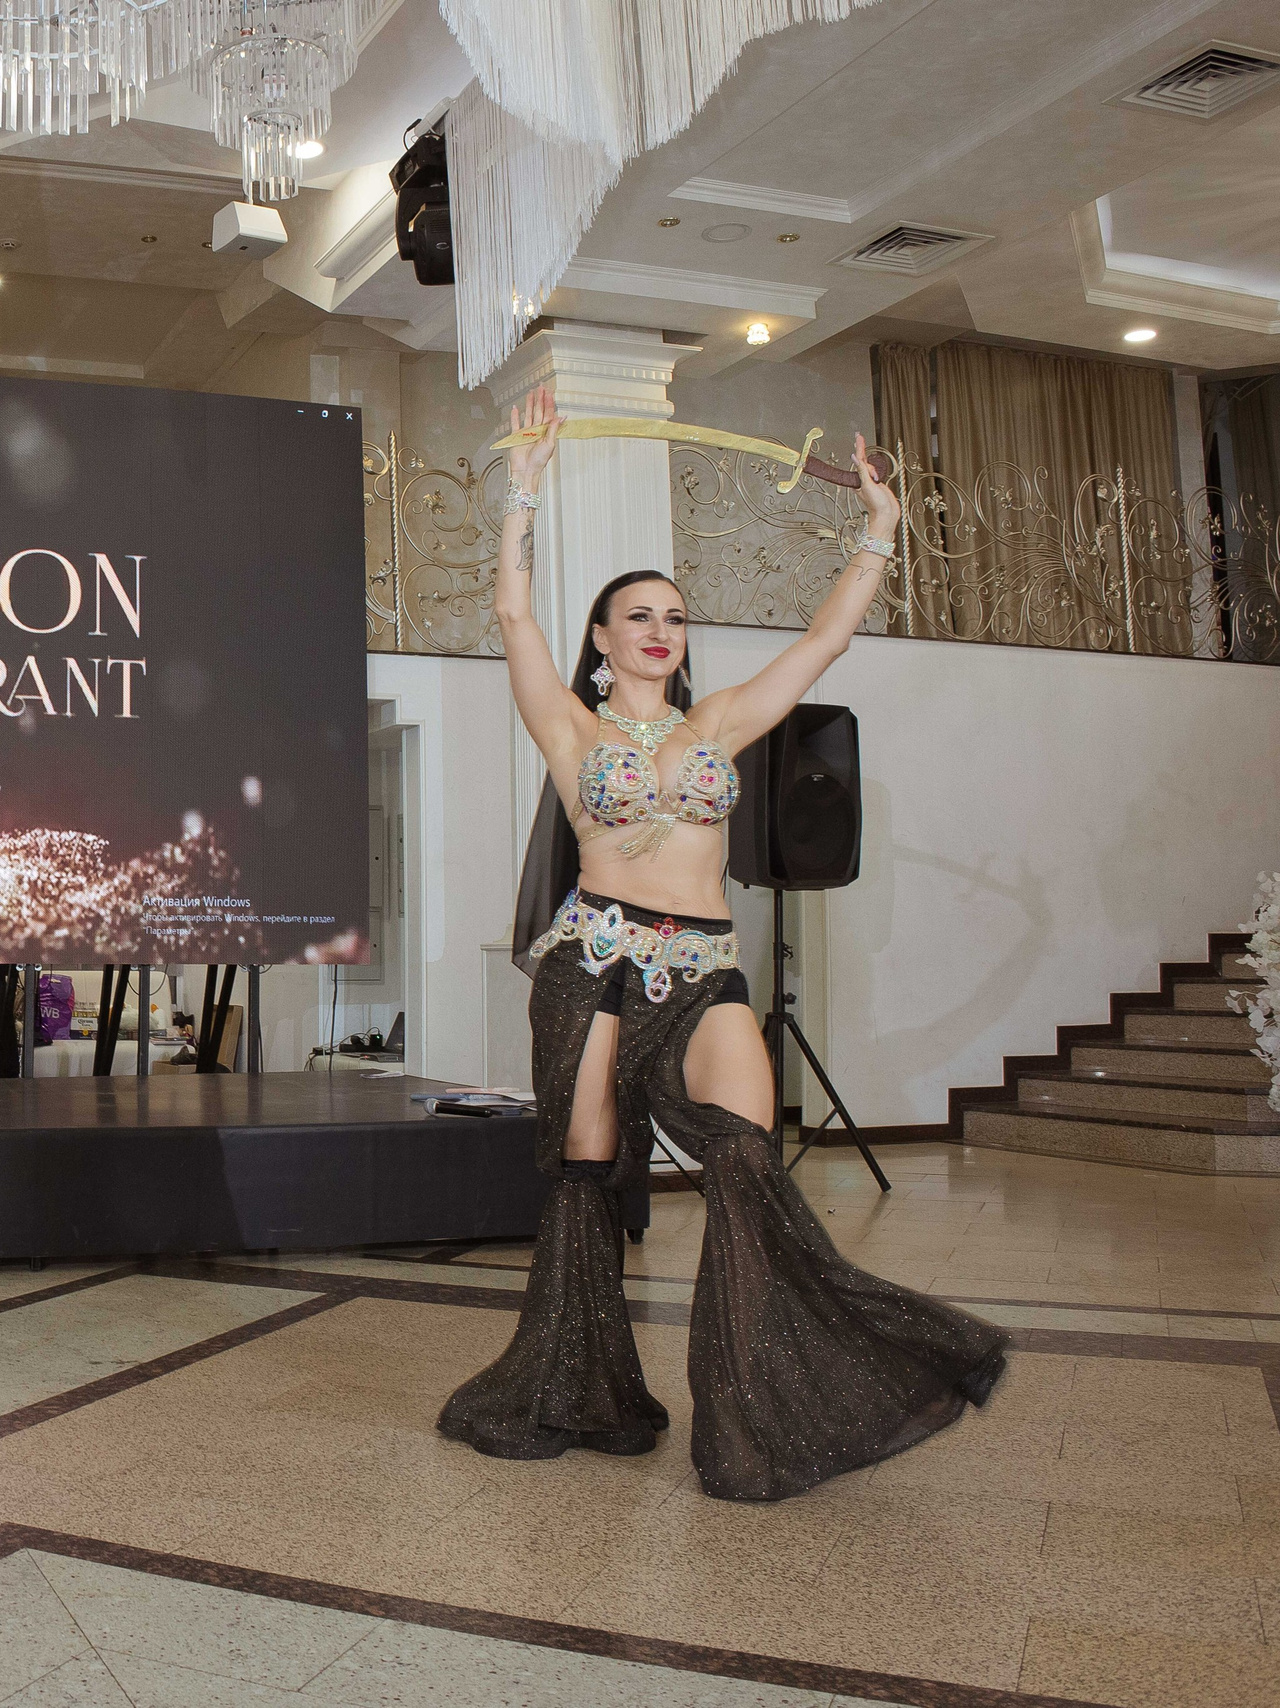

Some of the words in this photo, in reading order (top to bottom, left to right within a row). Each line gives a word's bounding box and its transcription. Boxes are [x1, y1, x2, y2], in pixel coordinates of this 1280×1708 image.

[143, 895, 200, 907] Активация
[203, 896, 251, 907] Windows
[143, 912, 168, 922] Чтобы
[169, 914, 223, 923] активировать
[262, 914, 302, 924] перейдите
[303, 915, 308, 923] в
[309, 915, 336, 924] раздел
[40, 1006, 60, 1019] WB
